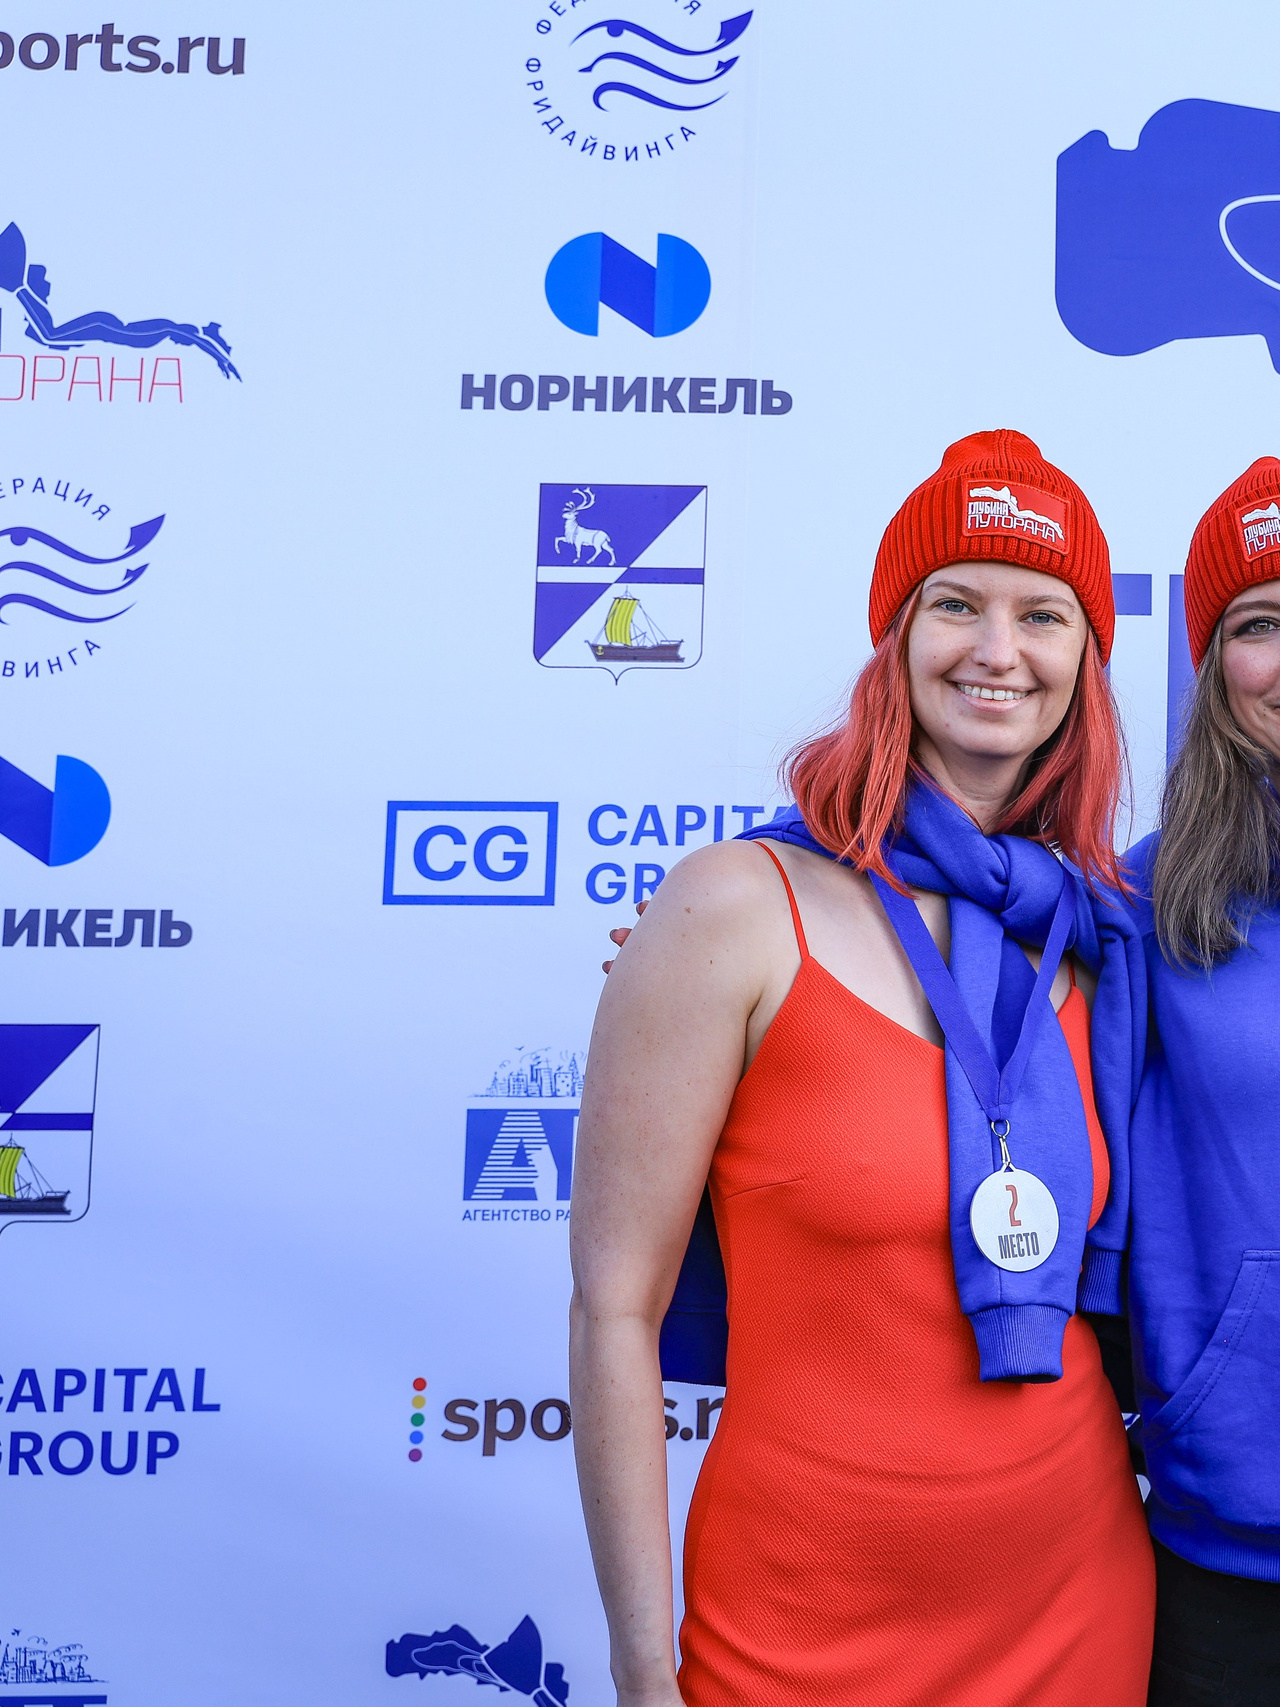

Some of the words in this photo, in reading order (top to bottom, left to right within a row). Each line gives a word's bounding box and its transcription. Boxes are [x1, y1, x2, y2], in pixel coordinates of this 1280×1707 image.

[526, 57, 697, 162] ФРИДАЙВИНГА
[461, 373, 793, 416] НОРНИКЕЛЬ
[967, 513, 1056, 543] ПУТОРАНА
[968, 501, 1009, 516] ГЛУБИНА
[1243, 518, 1280, 541] ГЛУБИНА
[587, 803, 789, 846] CAPIT
[413, 824, 529, 881] CG
[462, 1209, 551, 1222] АГЕНТСТВО
[1005, 1184, 1022, 1227] 2
[997, 1232, 1040, 1260] МЕСТО
[0, 1368, 221, 1413] APITAL
[0, 1430, 180, 1476] ROUP
